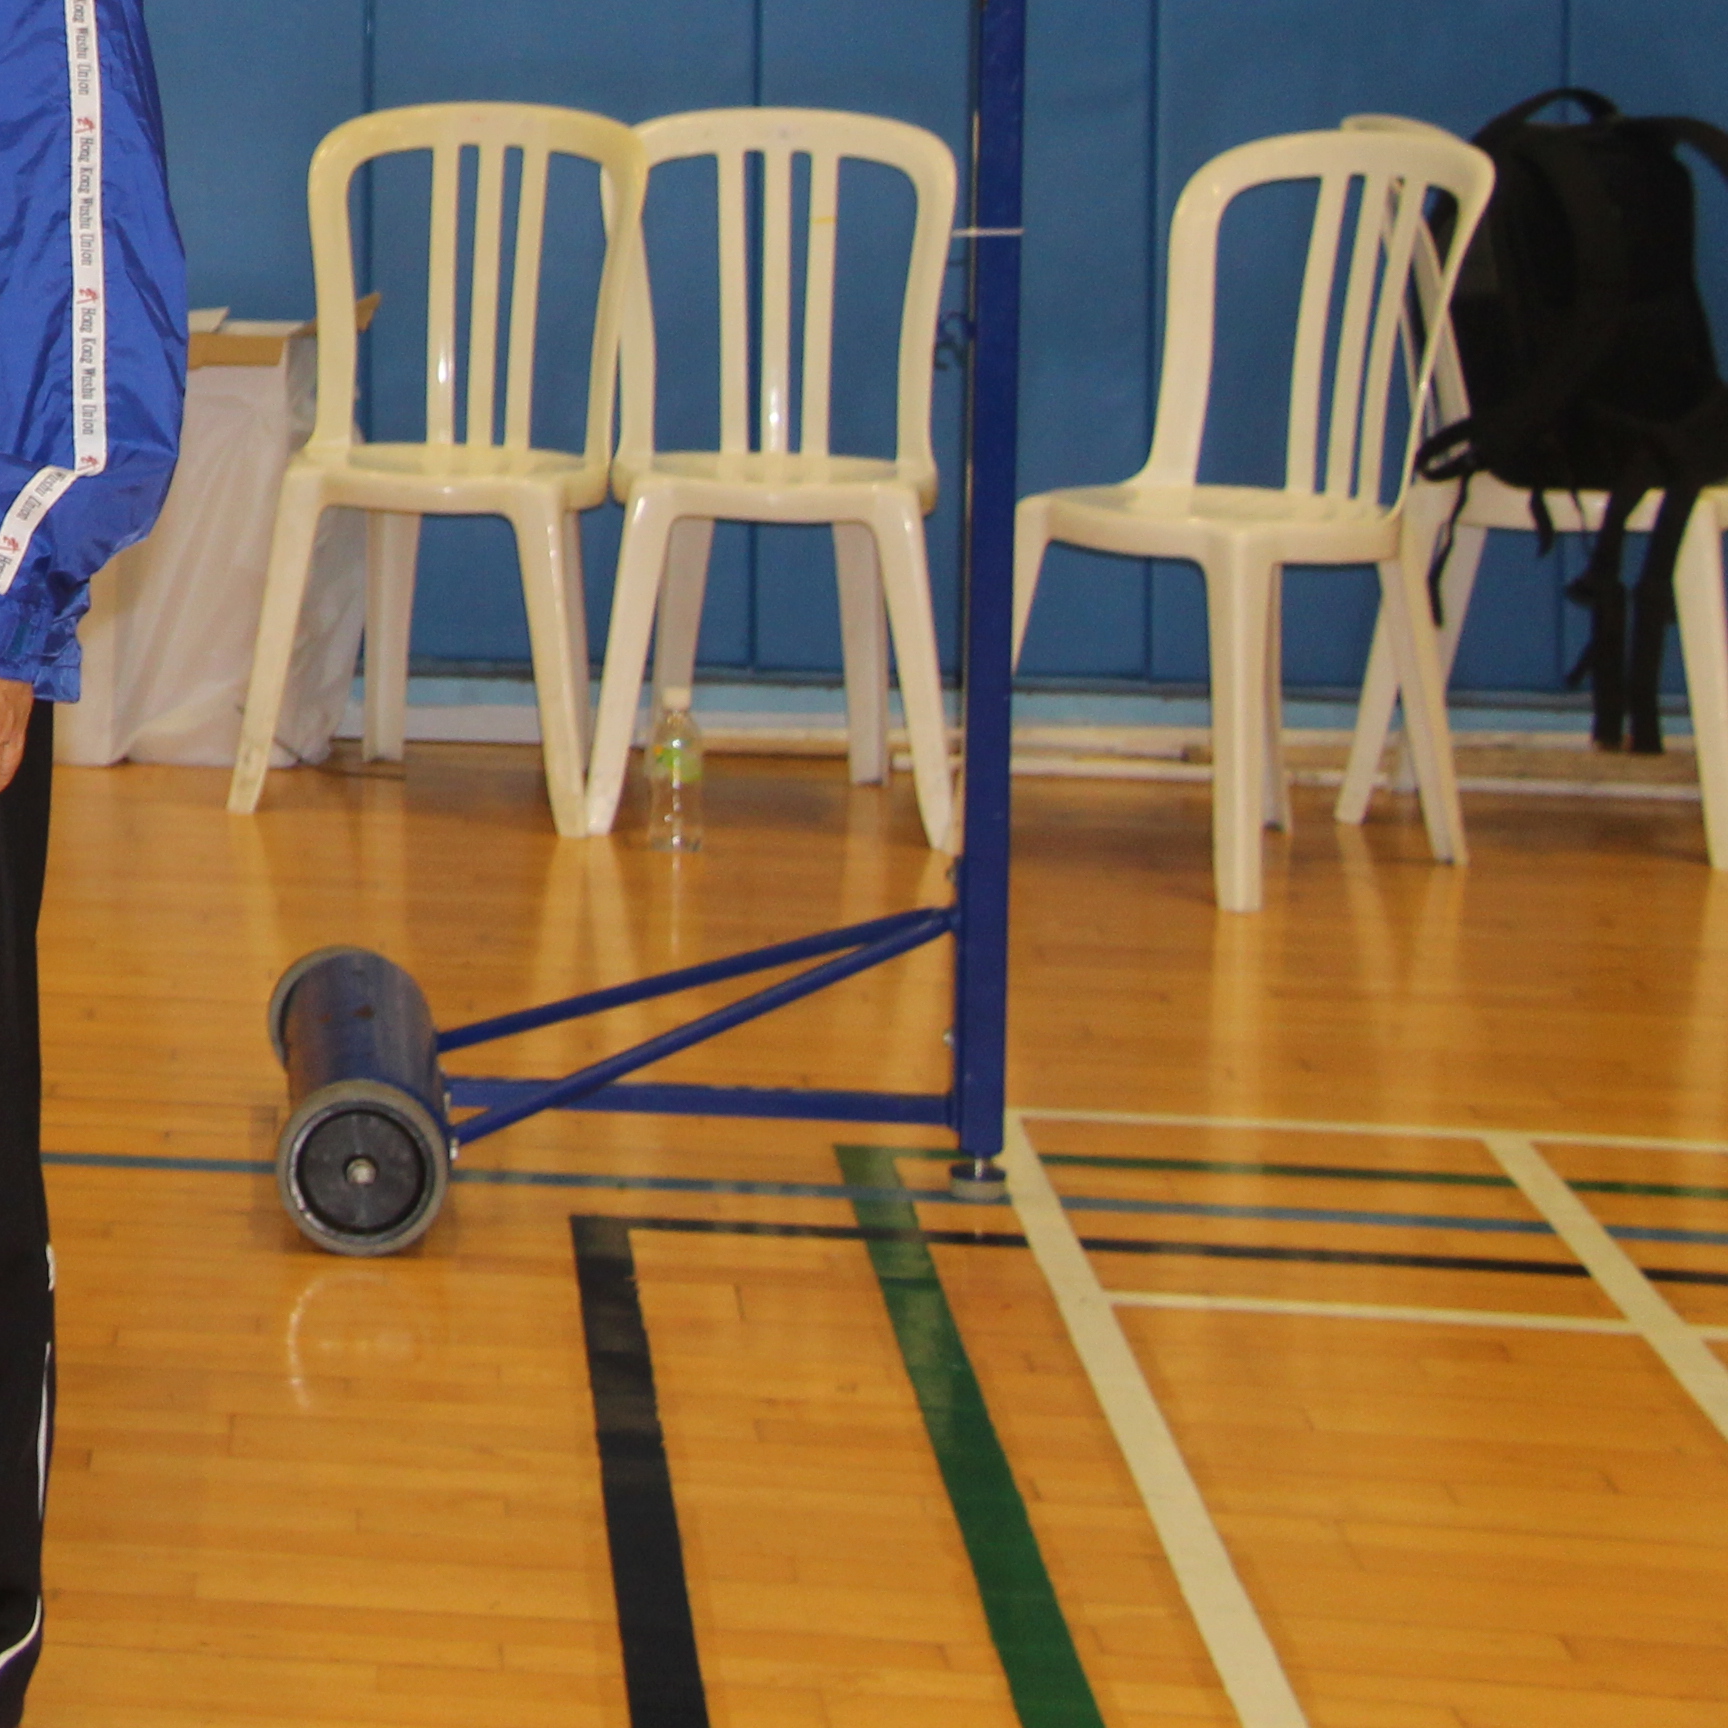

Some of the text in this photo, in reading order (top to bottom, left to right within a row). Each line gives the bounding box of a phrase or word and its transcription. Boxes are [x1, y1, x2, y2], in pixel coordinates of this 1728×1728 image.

[76, 27, 89, 59] Wushu
[77, 64, 91, 96] Union
[78, 136, 94, 267] Hong Kong Wushu Union
[80, 307, 97, 436] Hong Kong Wushu Union
